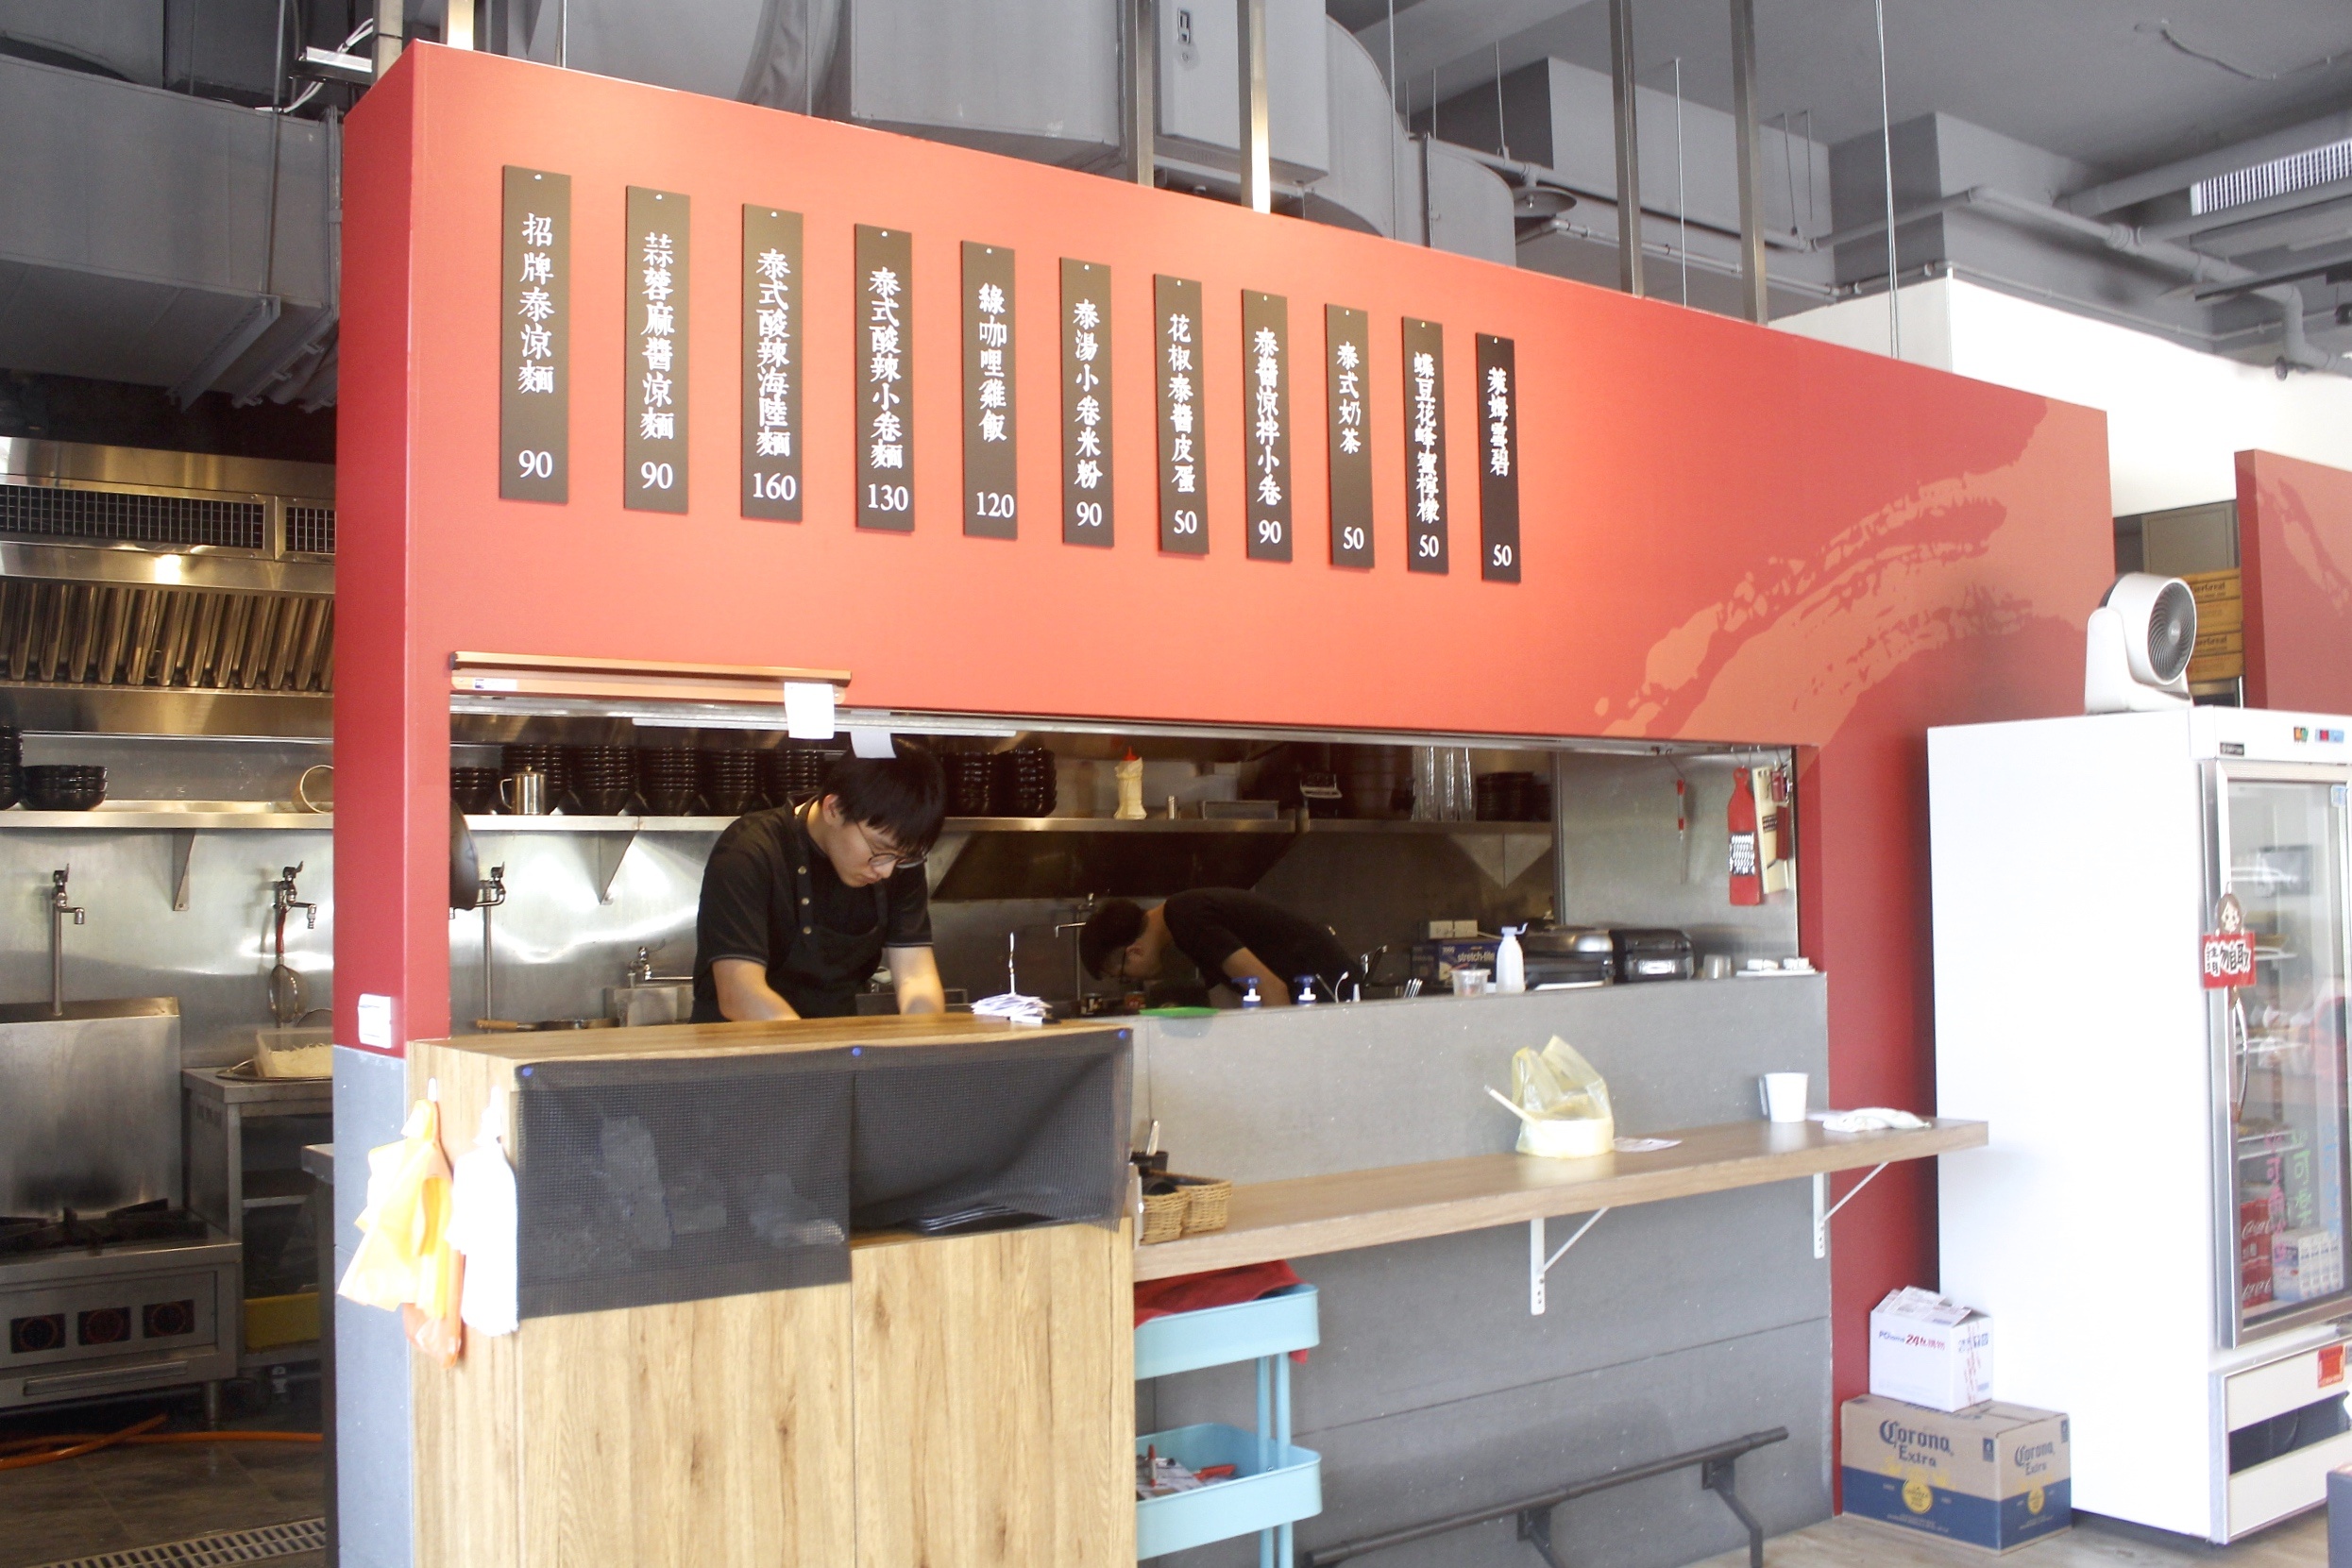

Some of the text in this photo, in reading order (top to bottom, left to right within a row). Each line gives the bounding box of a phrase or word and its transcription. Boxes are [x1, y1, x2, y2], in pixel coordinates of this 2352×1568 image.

[518, 212, 555, 395] 招牌泰涼麵
[640, 231, 675, 441] 蒜蓉麻醬涼麵
[755, 247, 791, 458] 泰式酸辣海陸麵
[868, 266, 904, 469] 泰式酸辣小卷麵
[978, 282, 1007, 443] 綠咖哩雞飯
[1073, 298, 1103, 490] 泰湯小卷米粉
[1167, 312, 1196, 493] 花椒泰醬皮蛋
[1336, 341, 1362, 455] 泰式奶茶
[1252, 326, 1282, 506] 泰醬涼拌小卷
[1487, 366, 1510, 477] 萊姆雪碧
[1413, 351, 1440, 524] 蝶豆花蜂蜜檸檬
[518, 449, 553, 479] 90
[640, 461, 674, 490] 90
[753, 472, 797, 501] 160
[867, 483, 909, 512] 130
[976, 491, 1015, 518] 120
[1075, 501, 1103, 527] 90
[1173, 509, 1198, 534] 50
[1258, 519, 1282, 544] 90
[1343, 526, 1364, 550] 50
[1418, 534, 1440, 558] 50
[1493, 544, 1513, 566] 50
[1879, 1420, 1951, 1453] Corona
[1899, 1443, 1937, 1467] Extra
[2014, 1441, 2054, 1468] Corona
